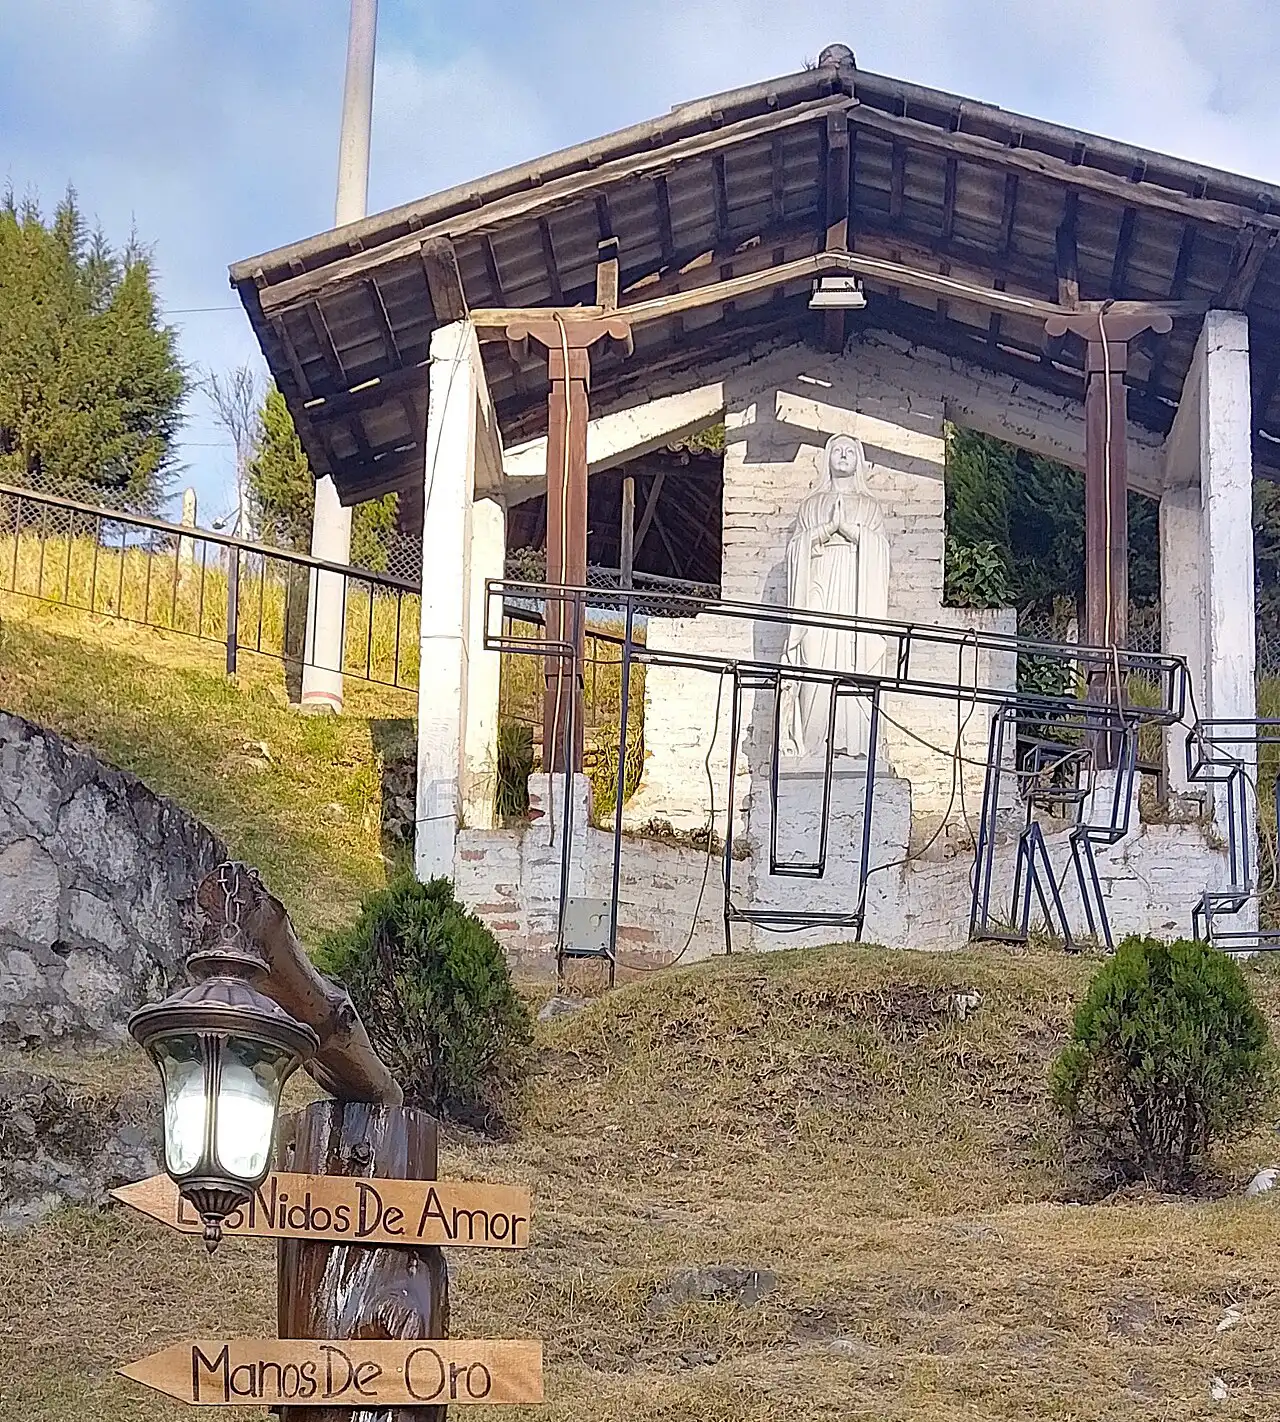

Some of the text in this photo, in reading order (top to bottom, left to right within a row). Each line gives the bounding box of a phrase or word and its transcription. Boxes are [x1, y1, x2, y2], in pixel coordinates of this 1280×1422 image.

[177, 1176, 527, 1244] Ls Nidos De Amor
[191, 1344, 492, 1402] Manos De Oro
